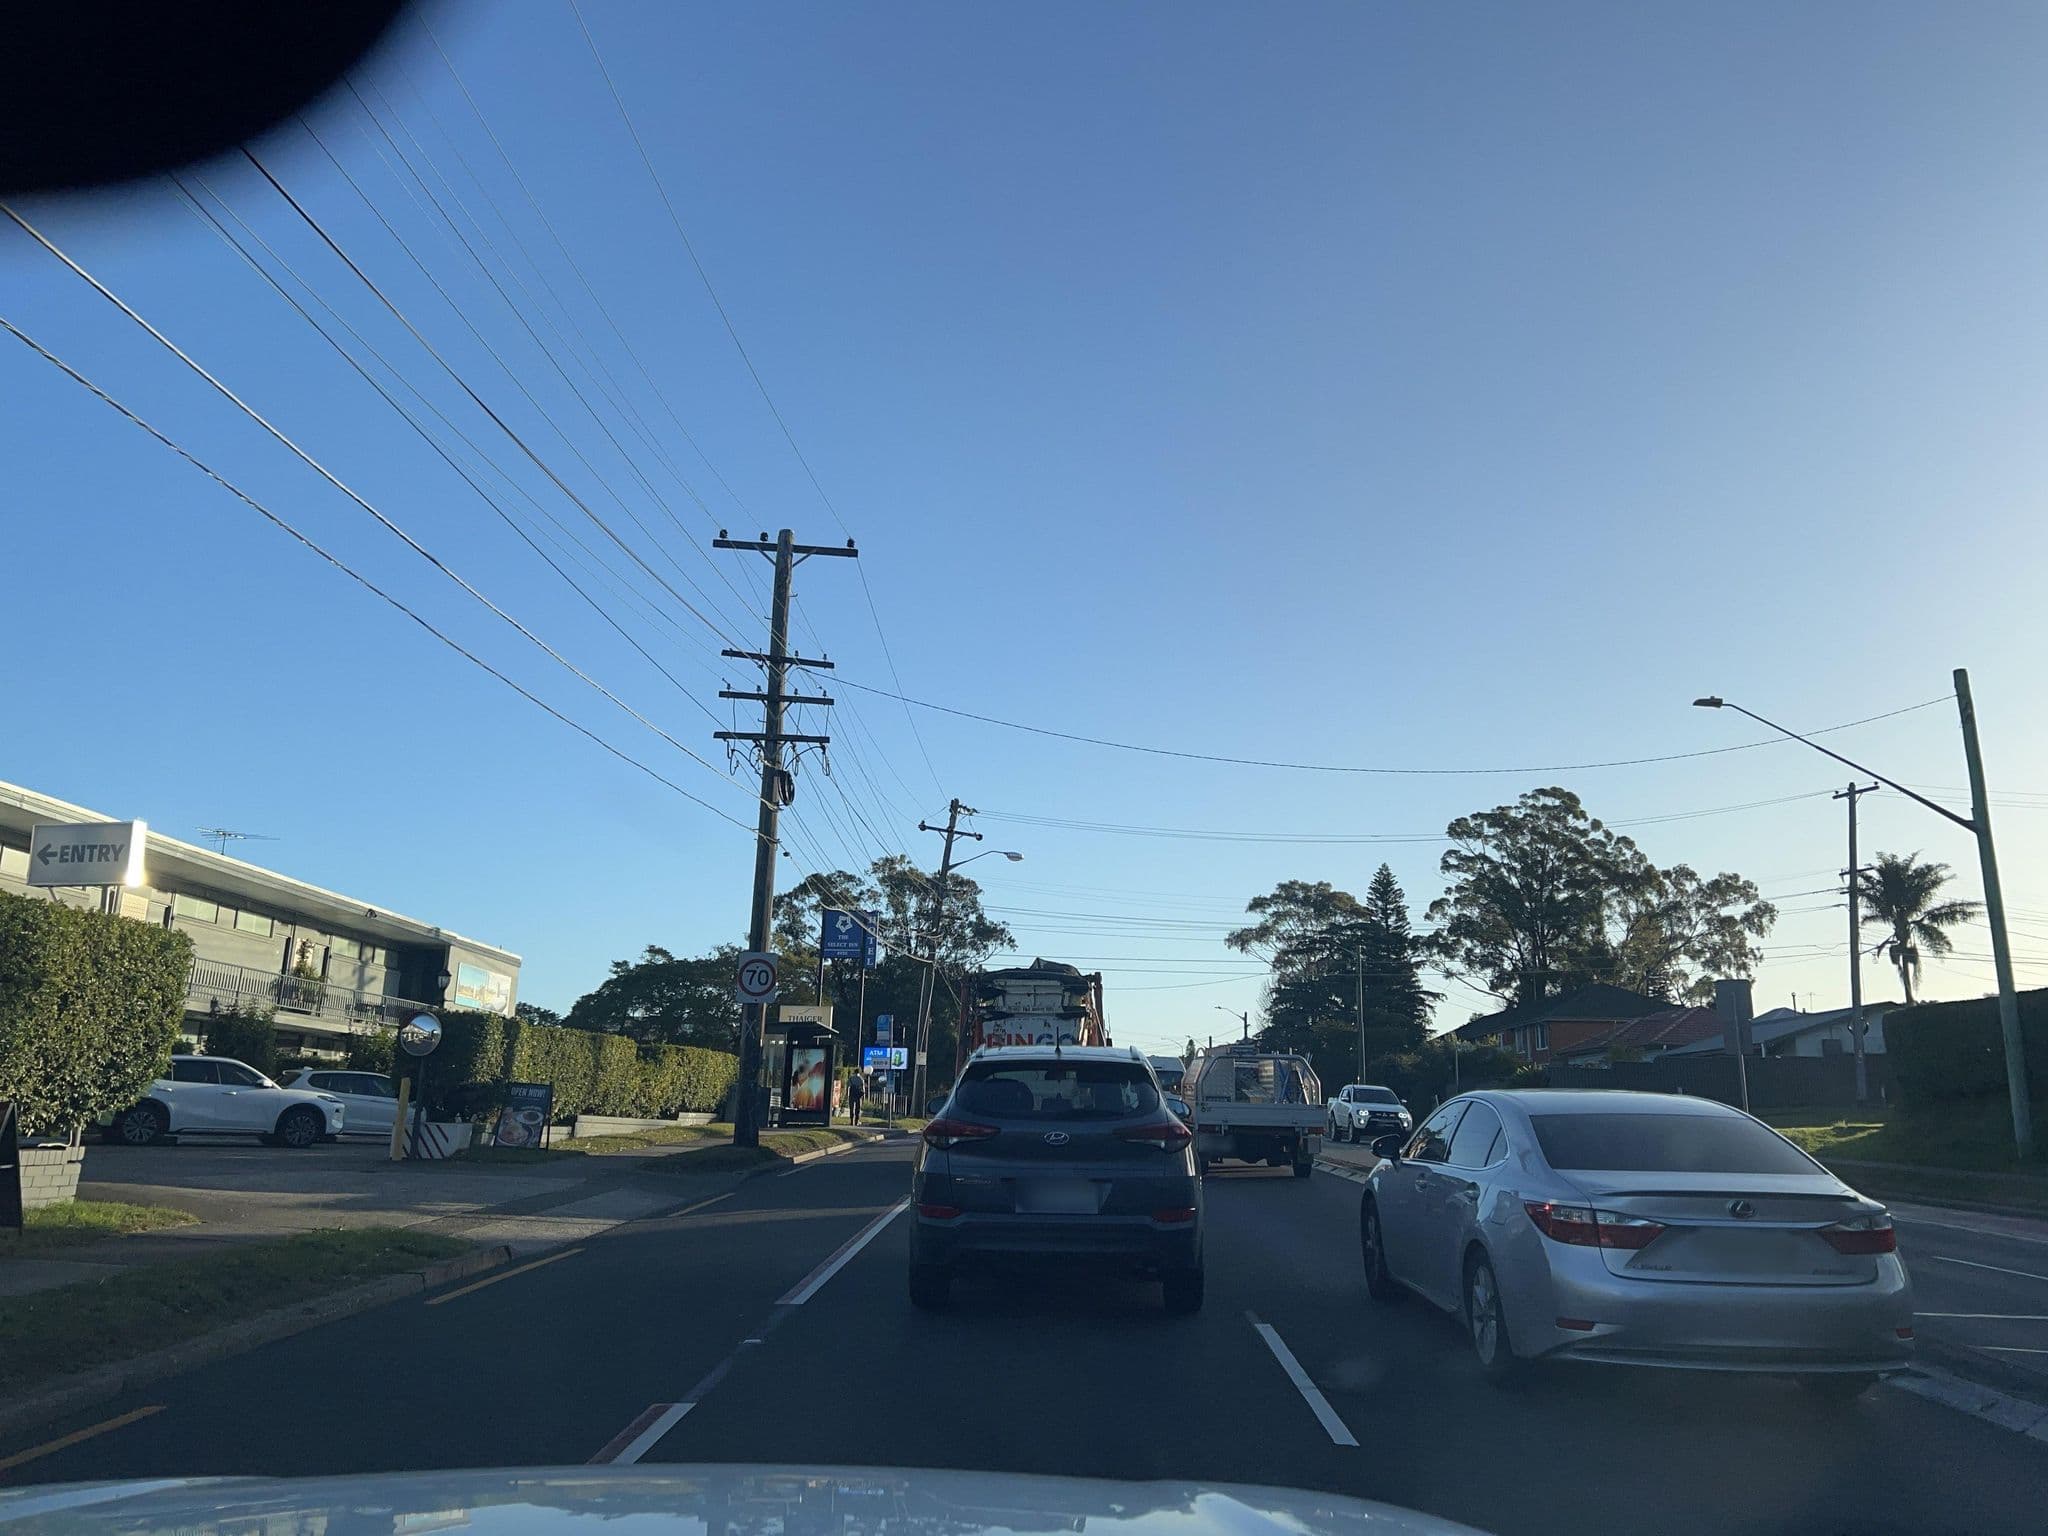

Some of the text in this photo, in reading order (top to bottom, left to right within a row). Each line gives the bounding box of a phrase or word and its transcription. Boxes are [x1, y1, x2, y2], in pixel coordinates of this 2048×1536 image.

[59, 844, 125, 863] ENTRY
[746, 969, 769, 986] 70
[511, 1086, 528, 1097] OPEN
